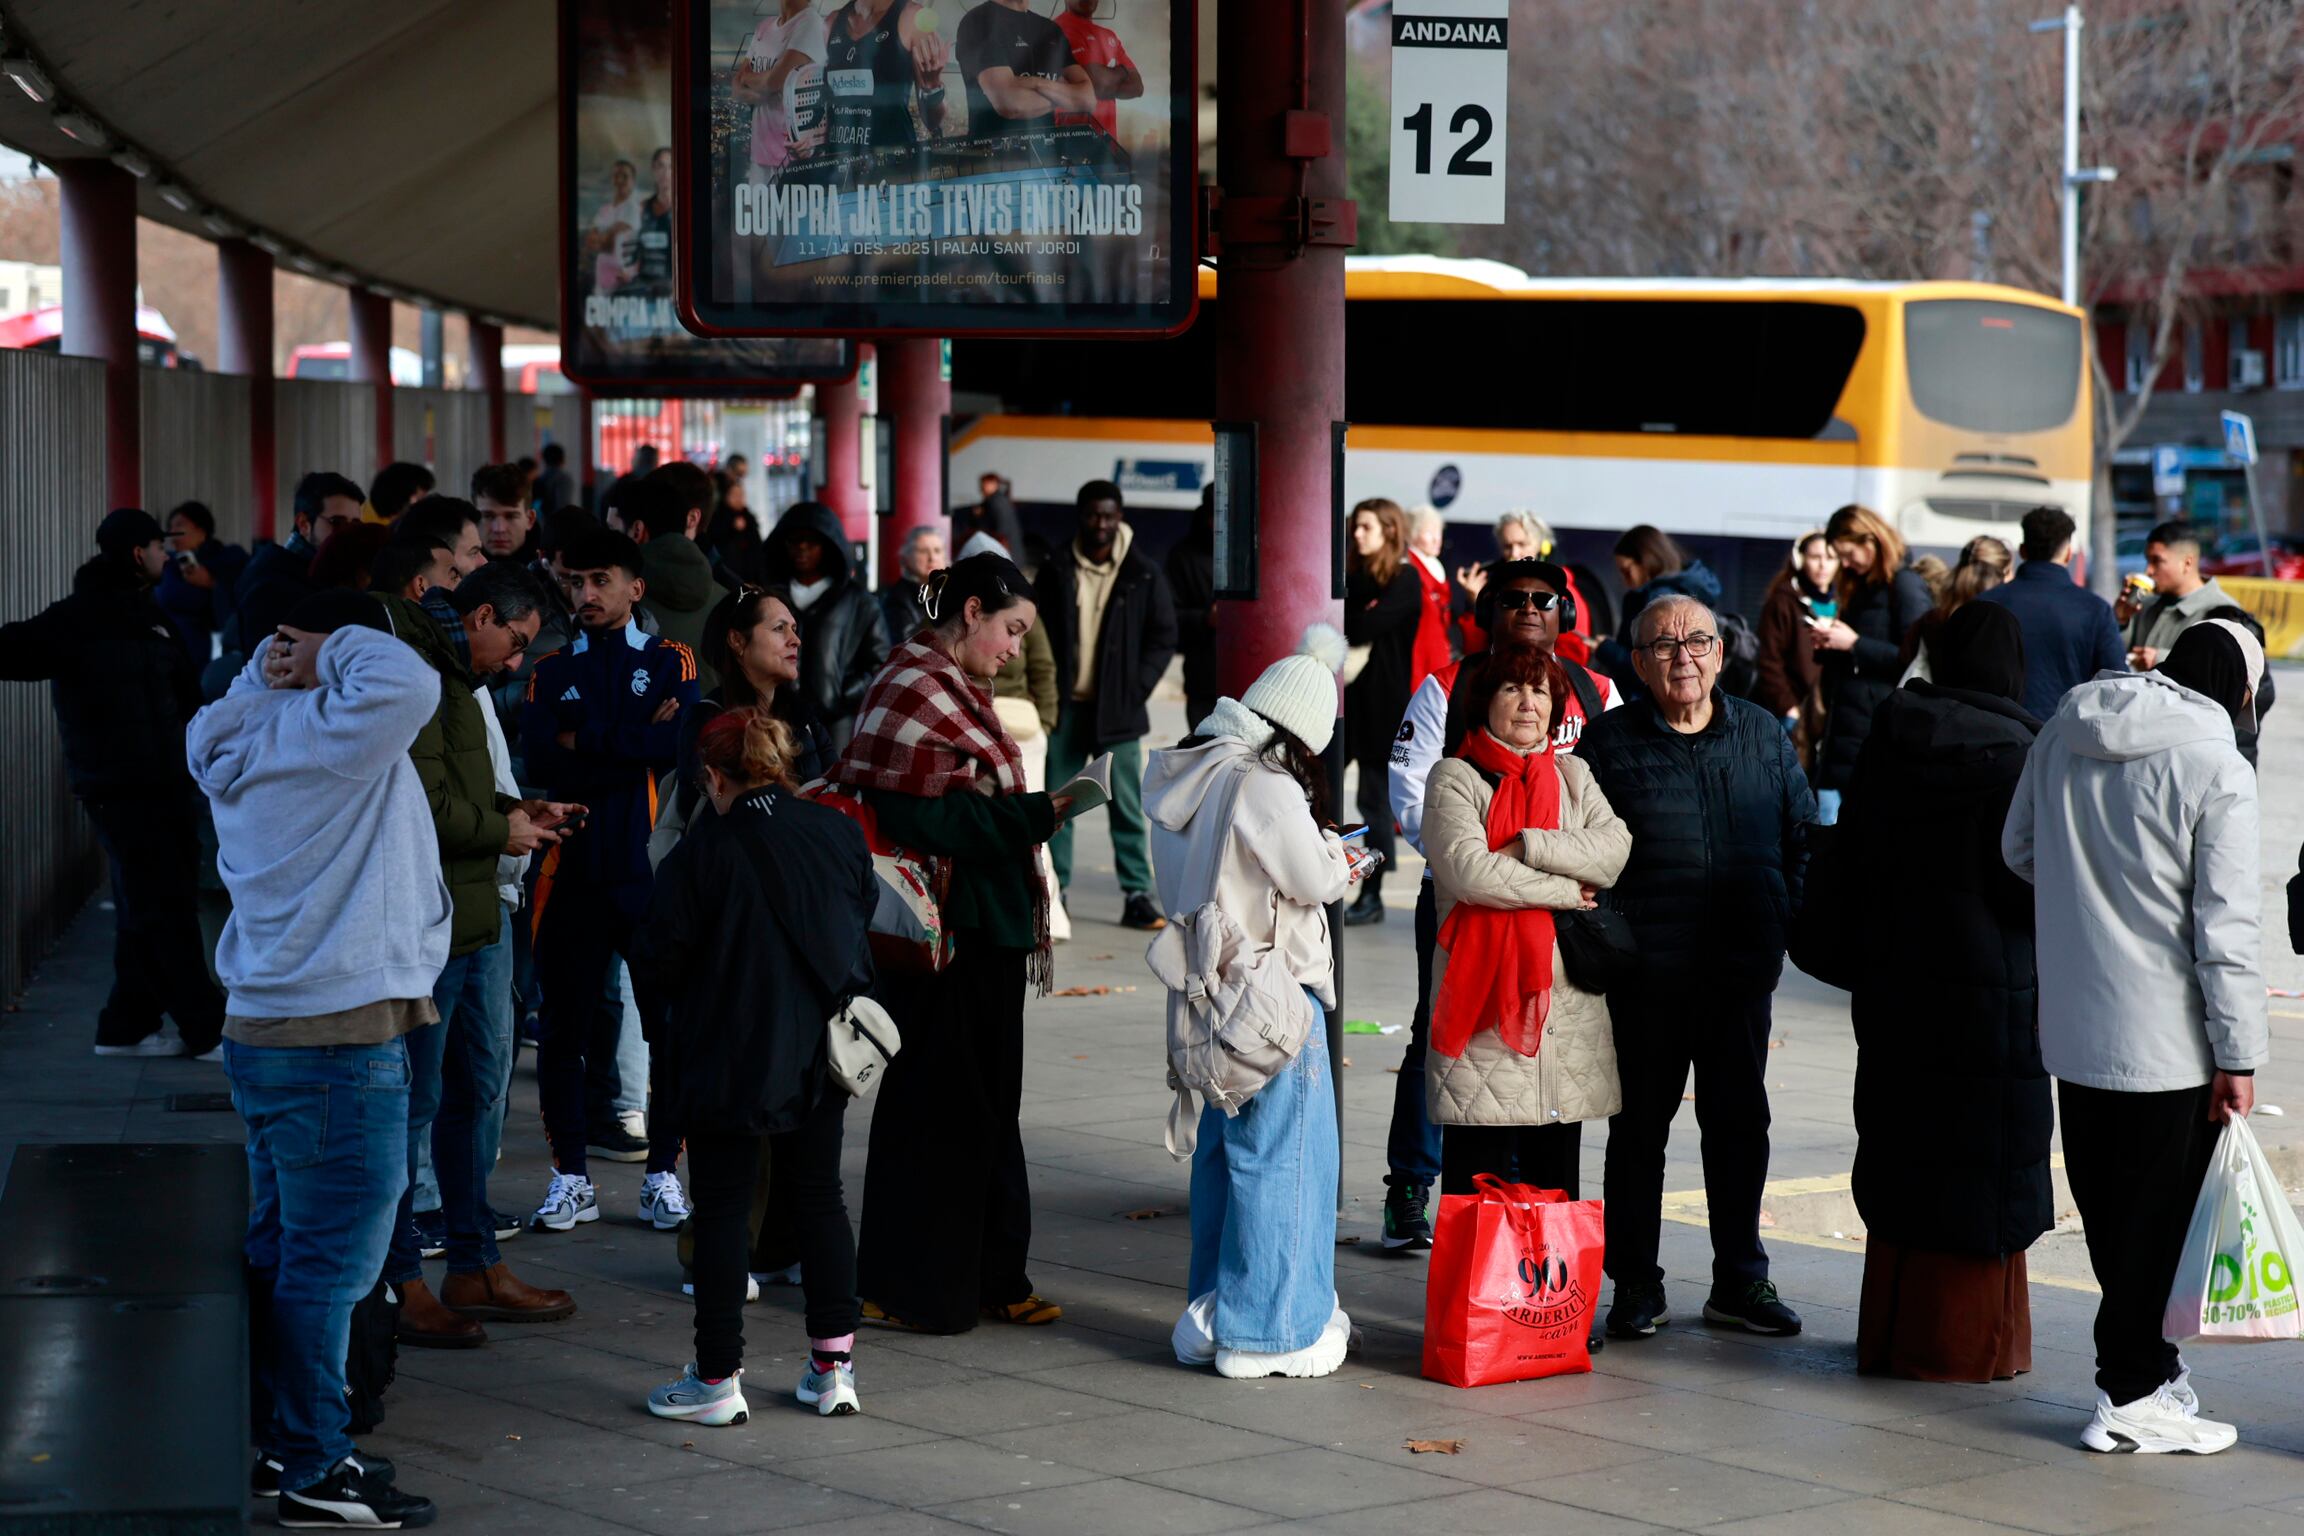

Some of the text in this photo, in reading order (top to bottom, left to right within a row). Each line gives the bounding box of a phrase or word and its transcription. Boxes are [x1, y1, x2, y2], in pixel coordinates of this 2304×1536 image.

[1400, 22, 1501, 43] ANDANA
[1403, 103, 1493, 176] 12
[735, 183, 842, 236] COMPRA
[889, 183, 932, 236] LES
[939, 183, 1013, 236] TEVES
[1020, 183, 1143, 236] ENTRADES
[799, 242, 816, 255] 11
[833, 242, 850, 255] 14
[854, 242, 887, 255] DES.
[893, 242, 930, 255] 2025
[942, 242, 990, 255] PALAU
[994, 242, 1032, 255] SANT
[1037, 242, 1080, 255] JORDI
[814, 271, 1065, 287] www.premierpadel.com/tourfinals
[585, 296, 649, 328] COMPRA
[1518, 1256, 1568, 1298] 90
[1508, 1299, 1579, 1325] ARDERIU
